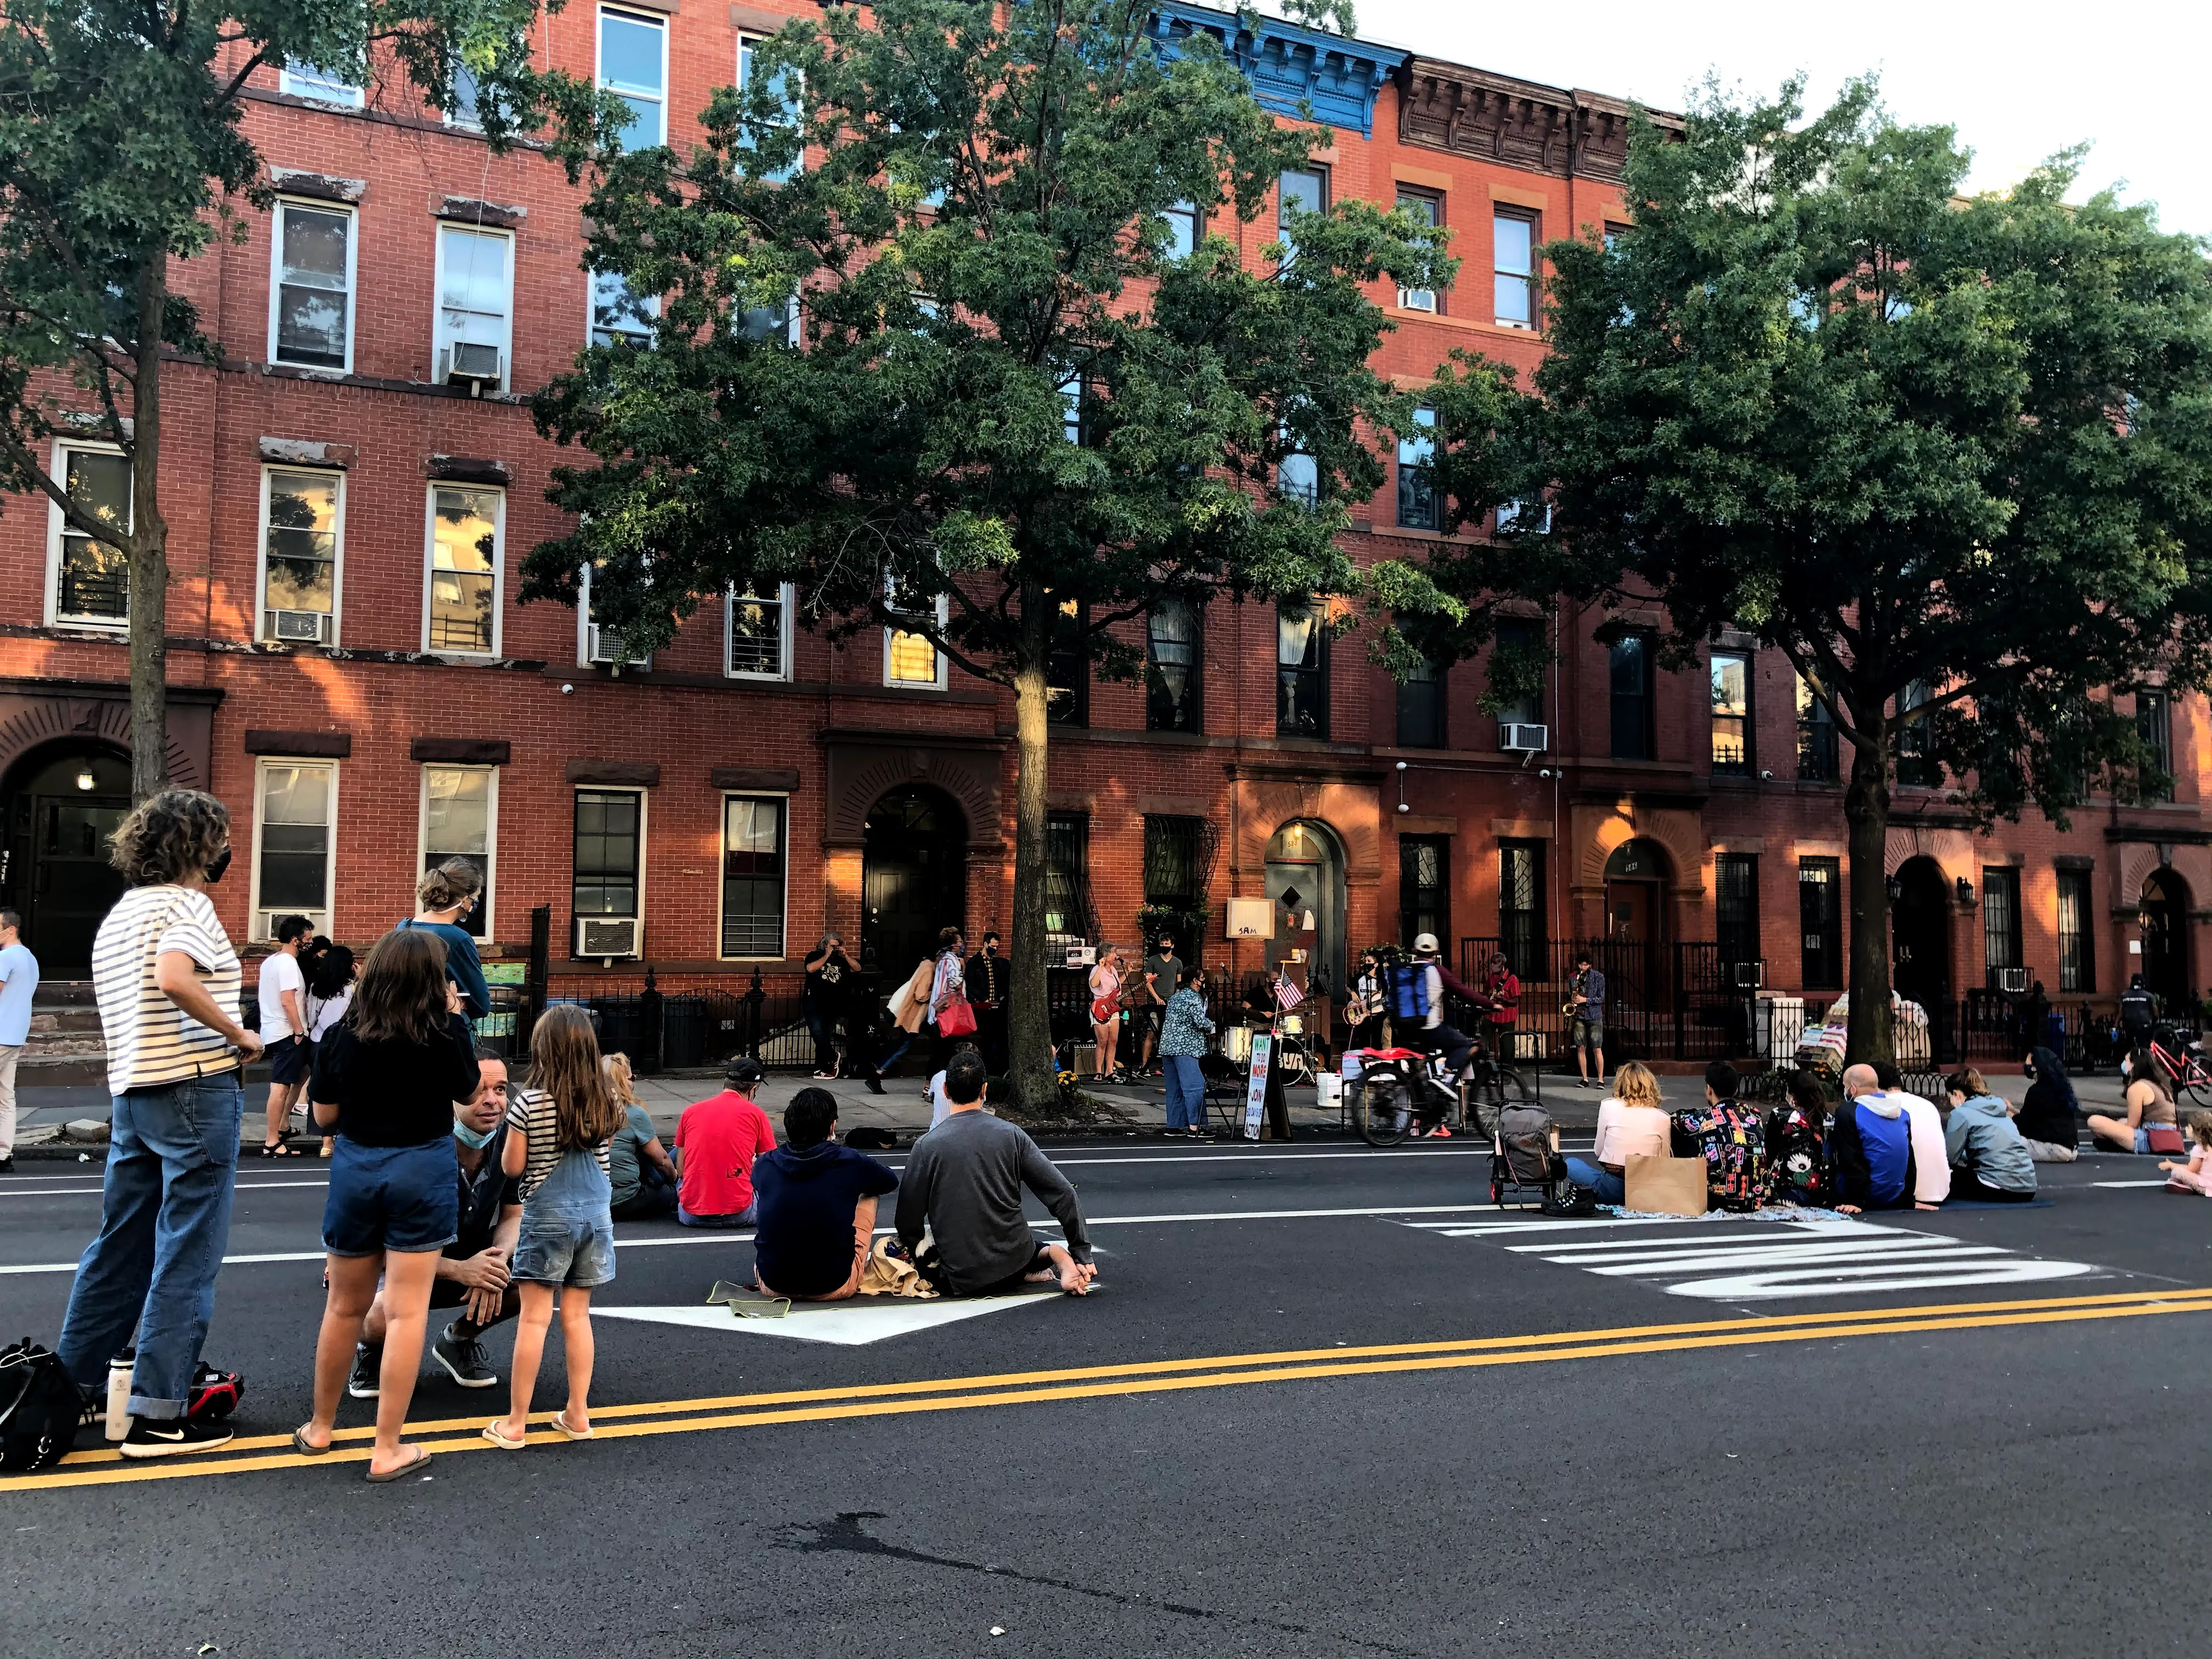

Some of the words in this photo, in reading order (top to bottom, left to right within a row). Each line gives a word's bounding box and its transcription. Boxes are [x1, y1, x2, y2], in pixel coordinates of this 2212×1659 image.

[1288, 839, 1297, 848] 588
[1254, 1037, 1270, 1051] WANT
[1252, 1064, 1267, 1078] MORE
[1251, 1088, 1262, 1103] JOIN
[1244, 1122, 1261, 1137] ACTION
